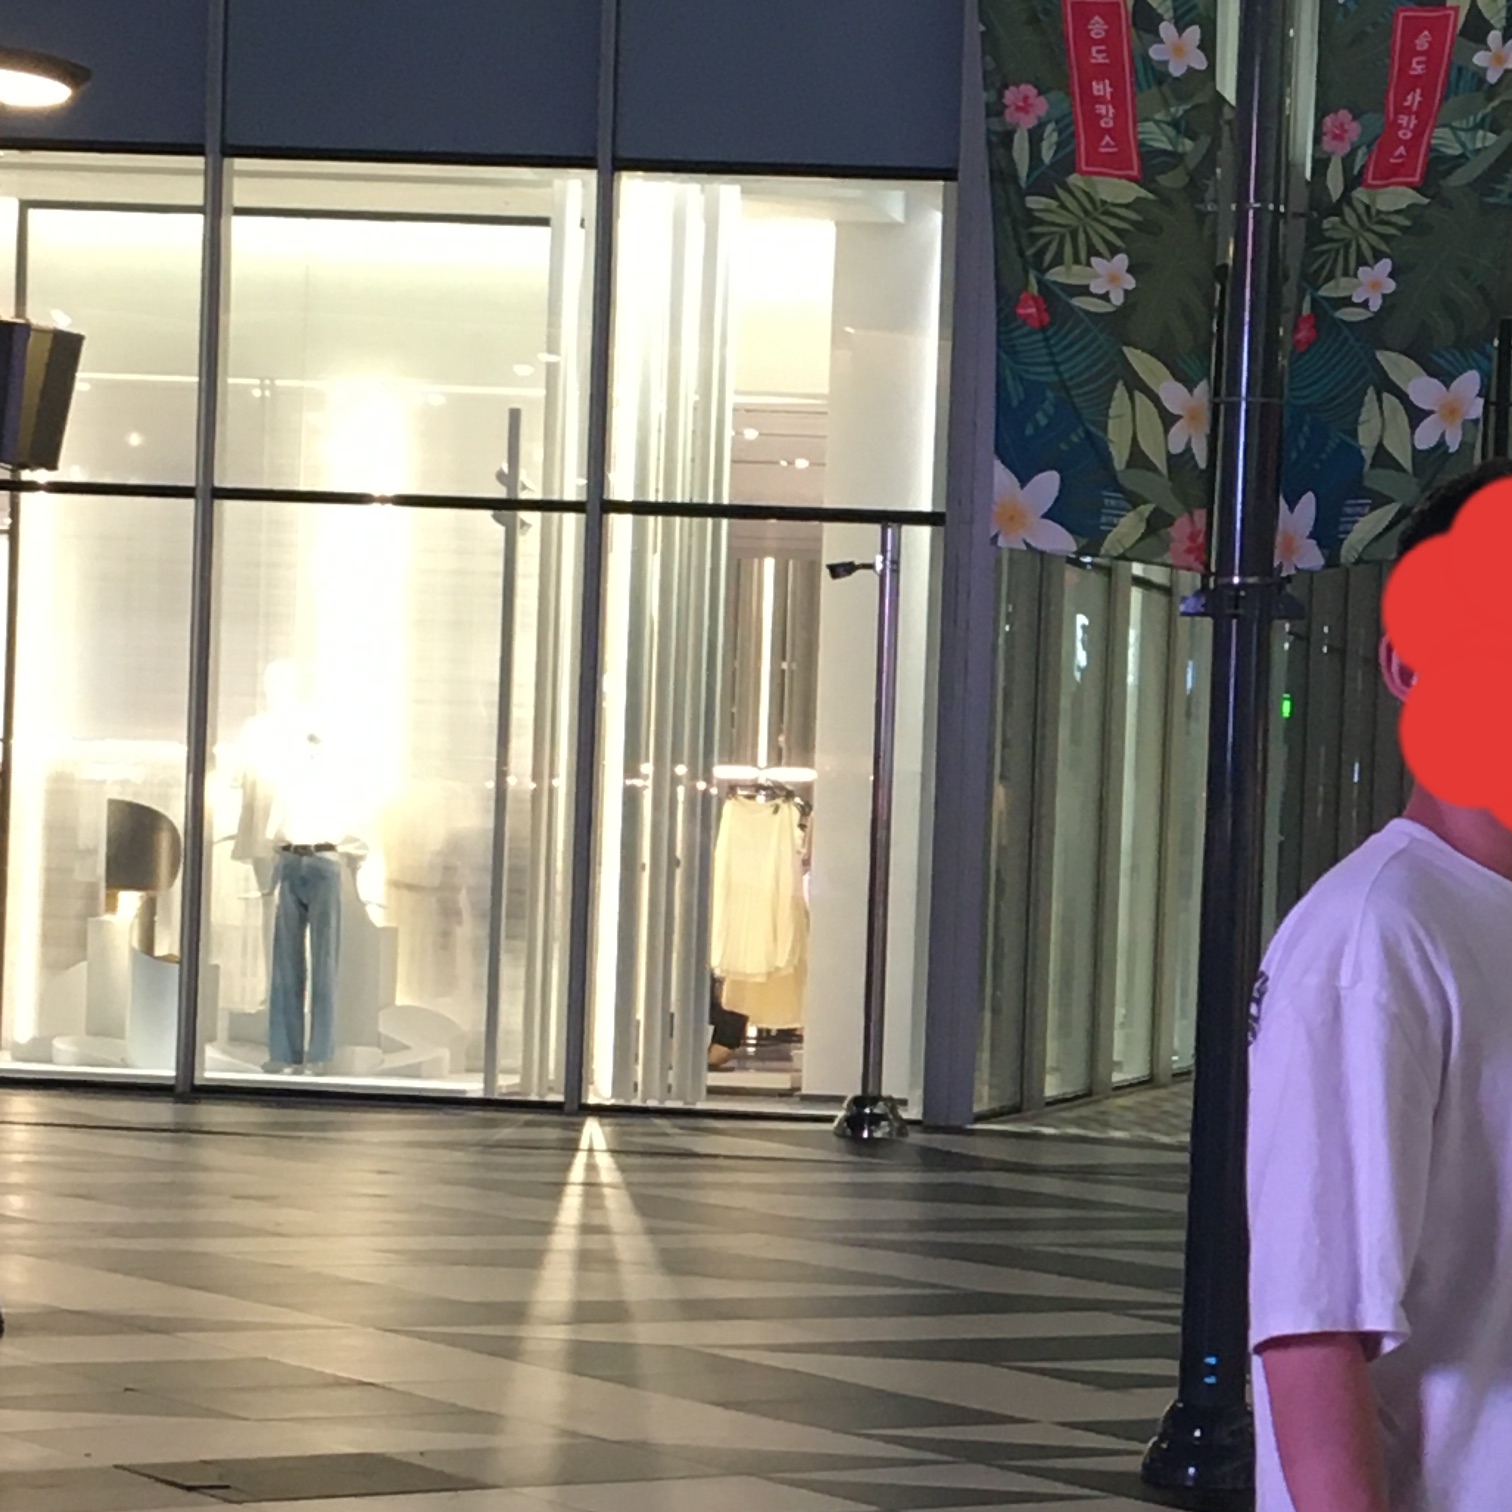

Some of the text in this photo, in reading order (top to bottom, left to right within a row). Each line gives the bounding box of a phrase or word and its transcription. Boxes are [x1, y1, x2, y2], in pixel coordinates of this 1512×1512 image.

[1087, 14, 1119, 154] 송도 바캉스
[1408, 29, 1433, 75] 송도
